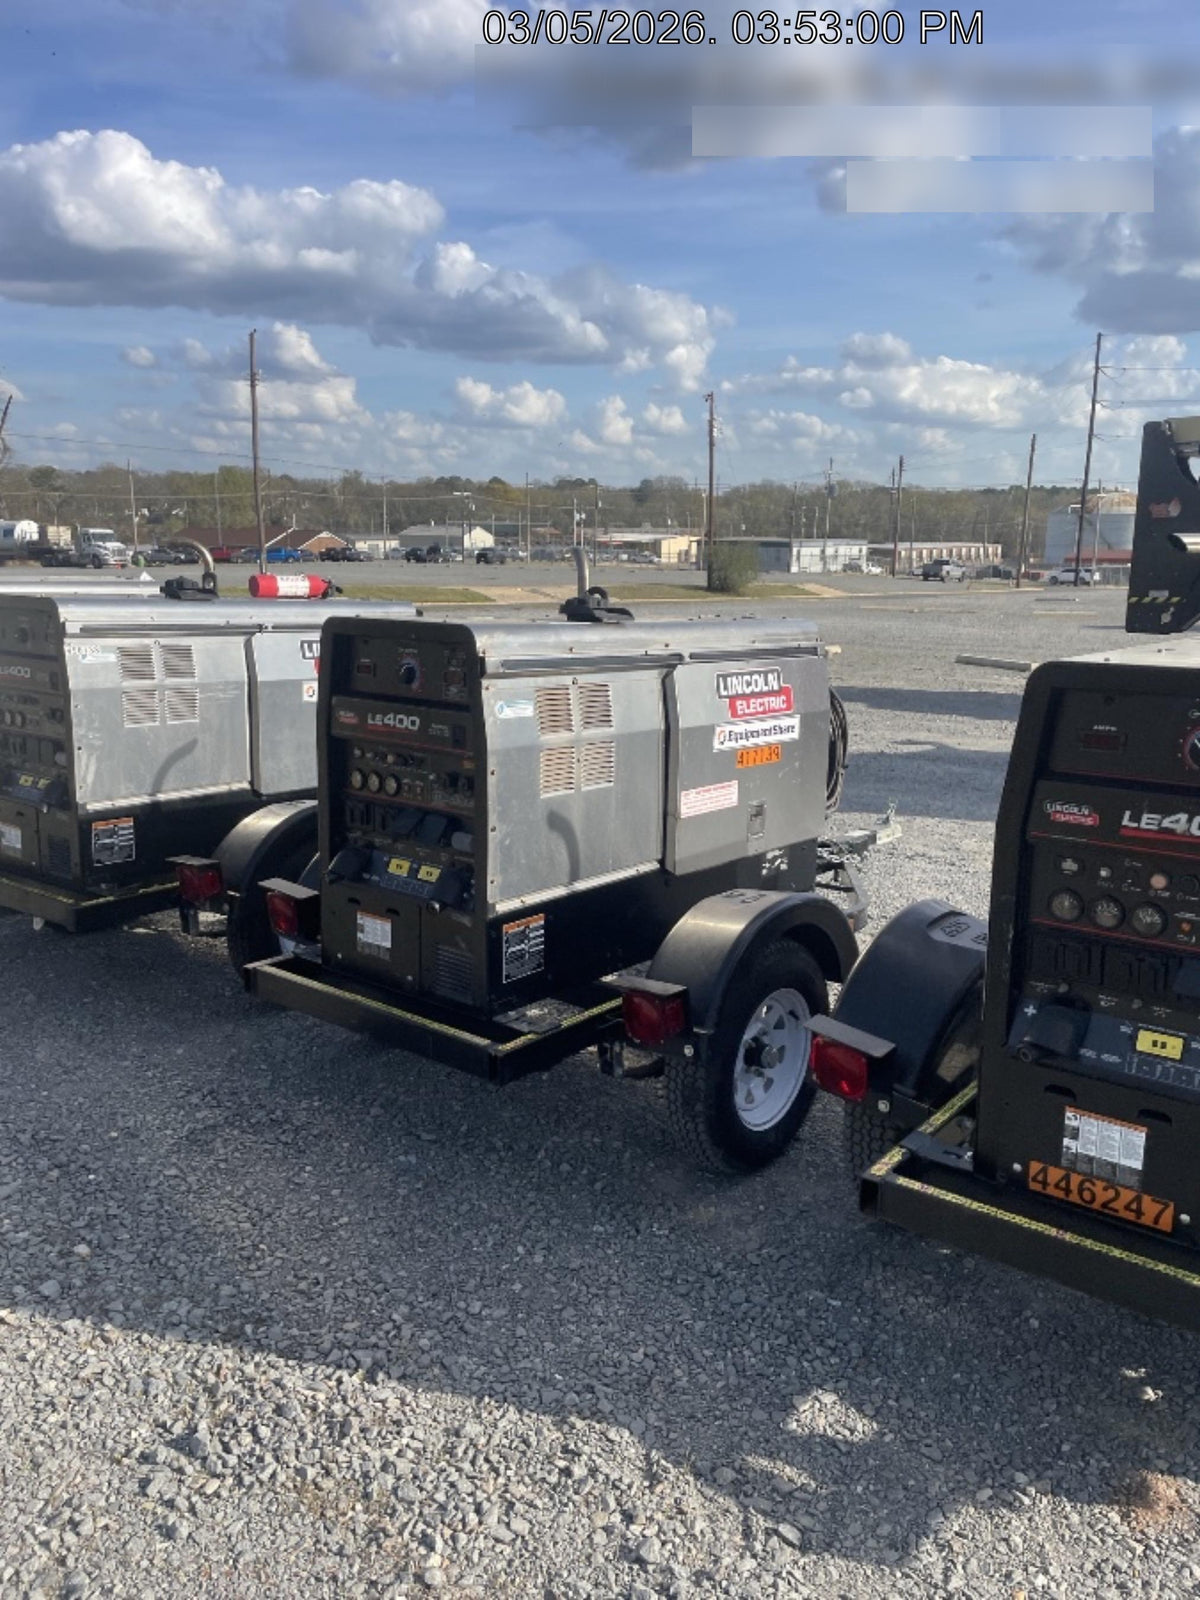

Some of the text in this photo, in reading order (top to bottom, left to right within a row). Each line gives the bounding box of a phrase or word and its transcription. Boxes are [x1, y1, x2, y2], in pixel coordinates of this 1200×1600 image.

[719, 673, 779, 696] LINCOLN
[735, 695, 787, 715] ELECTRIC
[367, 712, 421, 731] LE400
[737, 745, 781, 767] 417139
[1030, 1165, 1172, 1226] 446247
